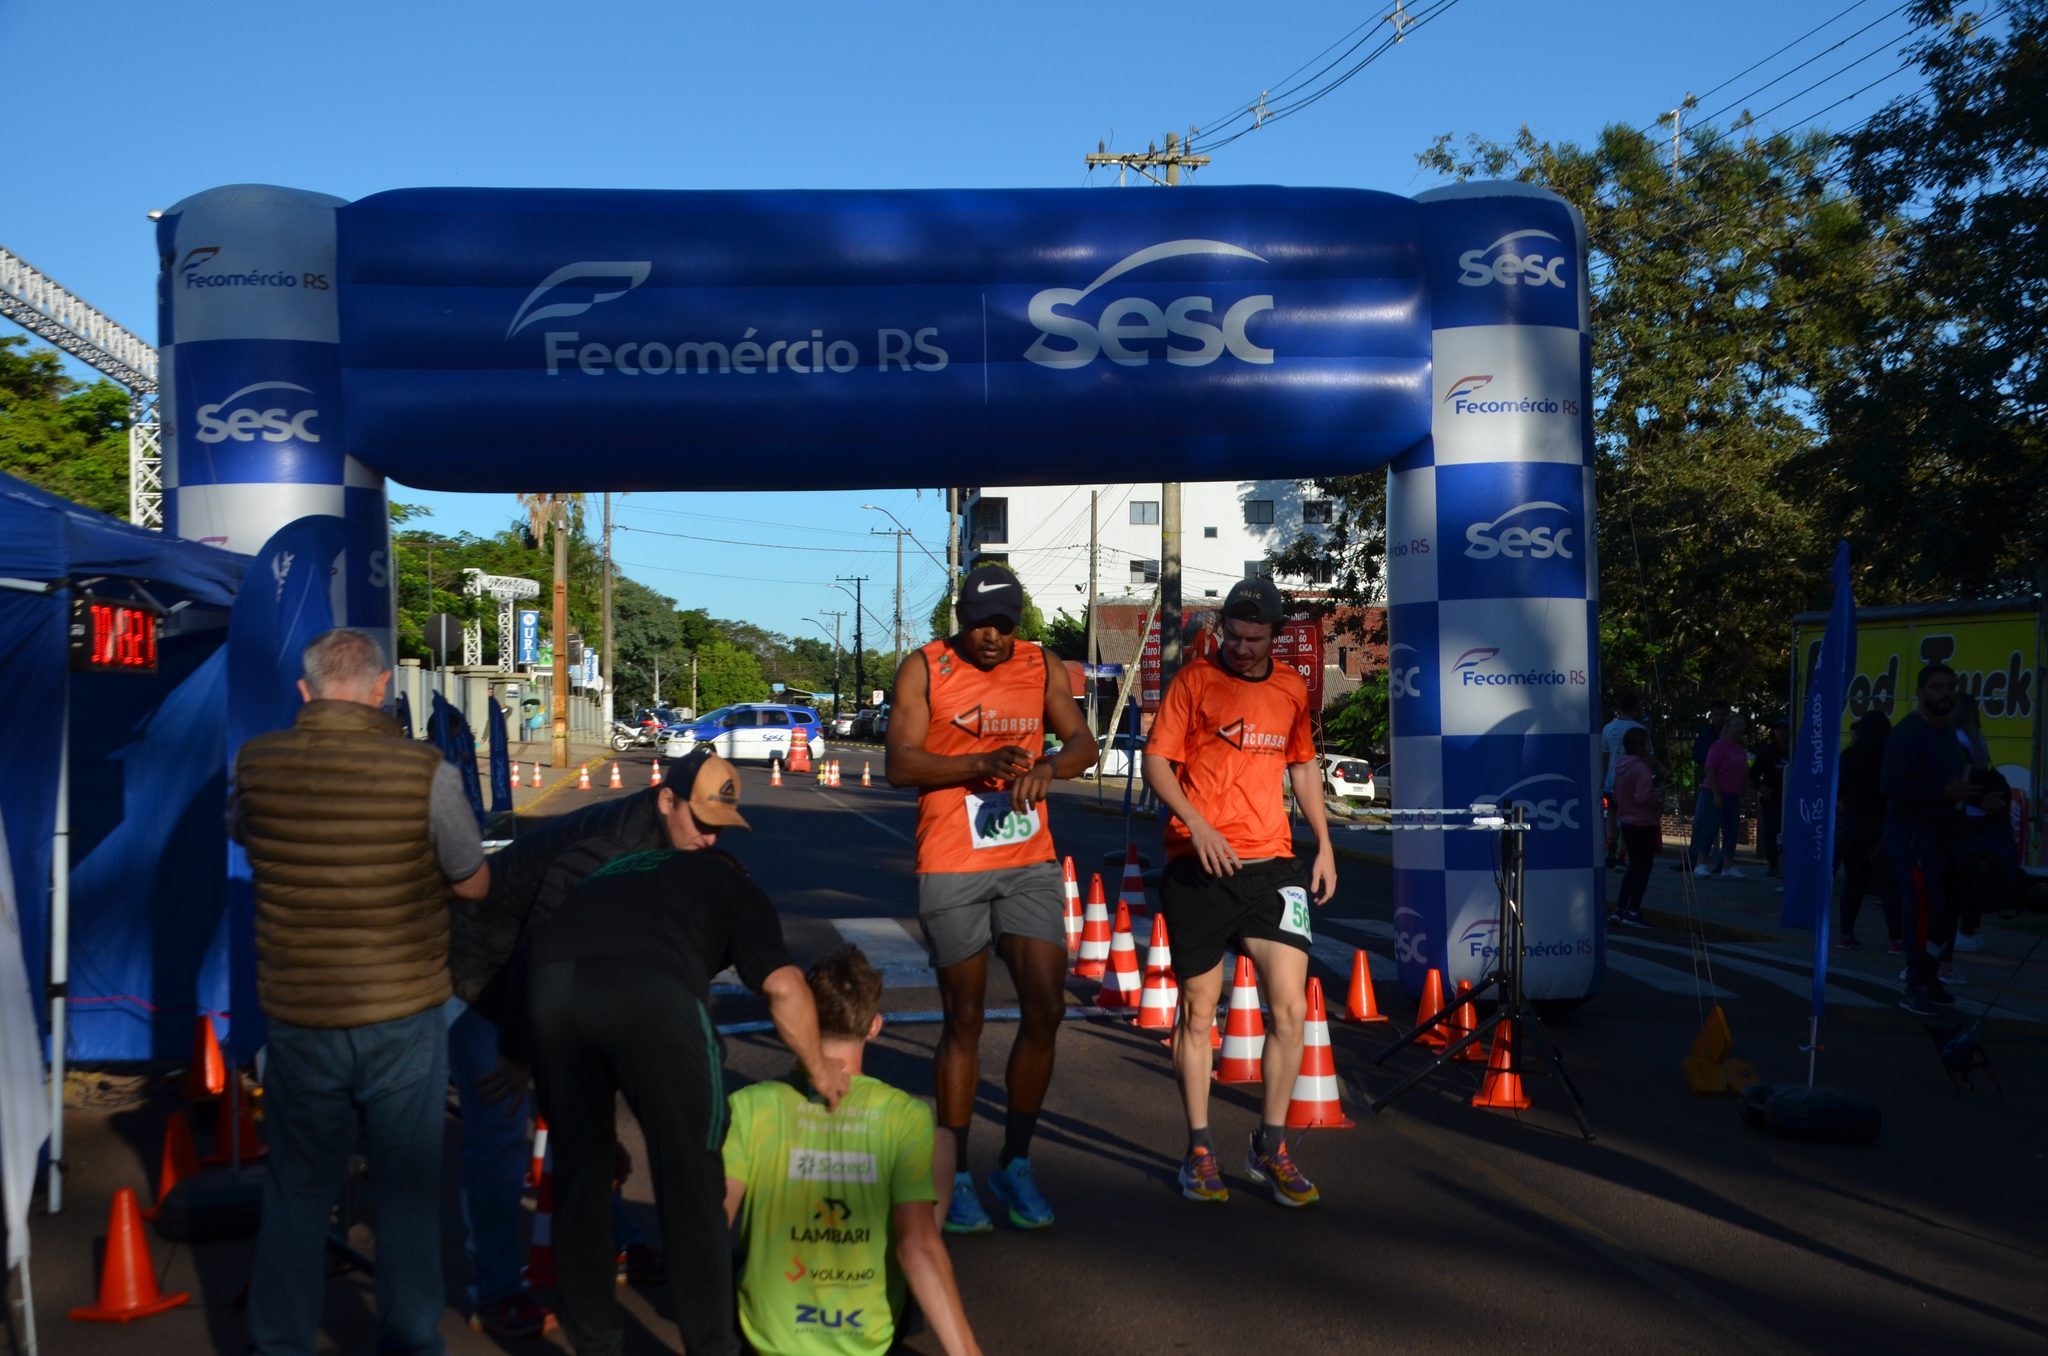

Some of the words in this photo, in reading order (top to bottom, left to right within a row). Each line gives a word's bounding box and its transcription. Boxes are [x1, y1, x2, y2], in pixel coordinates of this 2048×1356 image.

[187, 269, 297, 290] Fecomércio
[303, 272, 330, 291] RS
[1457, 249, 1566, 289] Sesc
[1021, 286, 1275, 370] Sesc
[545, 326, 859, 377] Fecomércio
[877, 327, 949, 373] RS
[1455, 394, 1559, 416] Fecomércio
[1562, 399, 1580, 417] RS
[194, 403, 320, 444] Sesc
[1411, 538, 1431, 555] RS
[1463, 521, 1574, 561] Sesc
[523, 627, 535, 661] URI
[1462, 666, 1566, 689] Fecomércio
[1569, 669, 1587, 687] RS
[1809, 692, 1825, 776] Sindicatos
[1576, 938, 1592, 955] RS
[791, 1226, 870, 1244] LAMBARI
[810, 1266, 876, 1281] VOLKANO
[796, 1303, 865, 1328] ZUK
